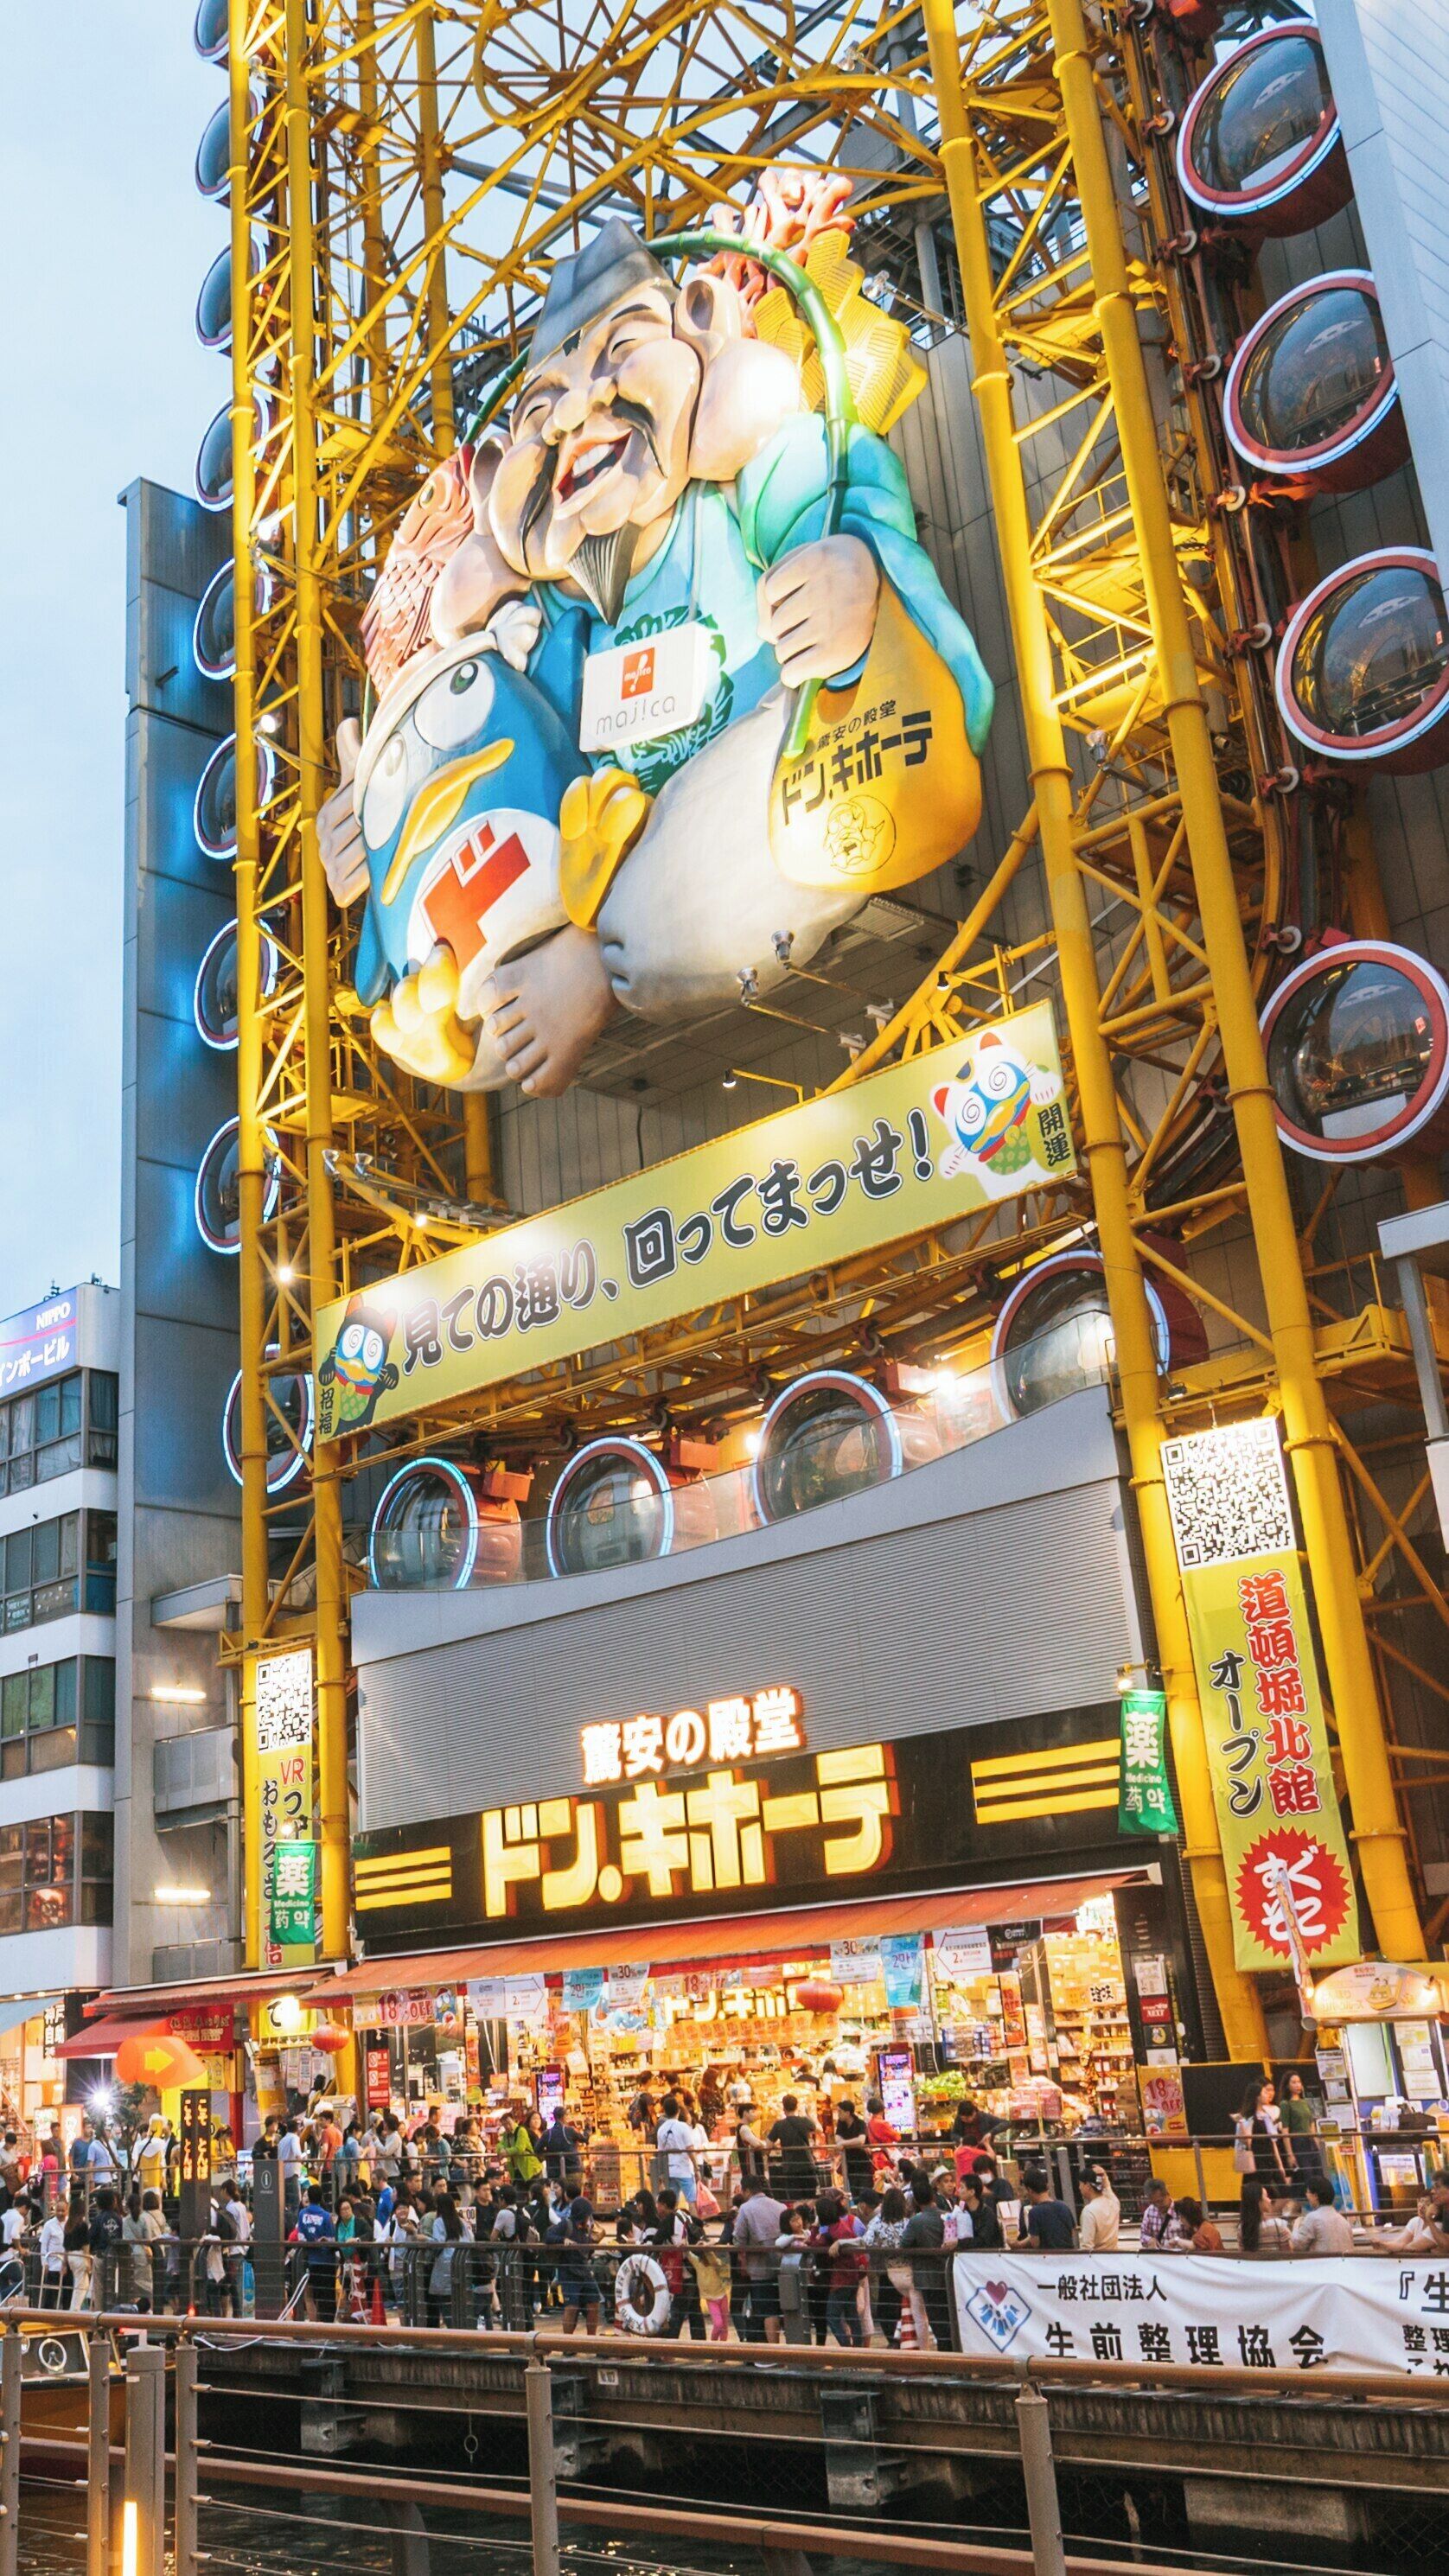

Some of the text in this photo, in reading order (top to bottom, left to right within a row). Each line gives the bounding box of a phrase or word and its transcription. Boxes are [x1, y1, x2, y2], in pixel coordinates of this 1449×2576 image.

[817, 699, 897, 751] 驚安の殿堂
[1037, 1102, 1070, 1167] 開運
[36, 1302, 71, 1331] NIPPO
[319, 1387, 335, 1435] 招福
[1239, 1569, 1321, 1817] 道頓堀北館
[582, 1688, 800, 1783] 驚安の殿堂
[1125, 1711, 1159, 1769] 薬
[1210, 1650, 1263, 1820] オープン
[1125, 1772, 1162, 1784] Medicine
[1146, 1787, 1165, 1814] 약
[277, 1855, 310, 1897] 薬
[274, 1900, 310, 1909] Medicine
[1037, 2274, 1167, 2302] 一般社団法人
[1044, 2322, 1329, 2369] 生前整理協会
